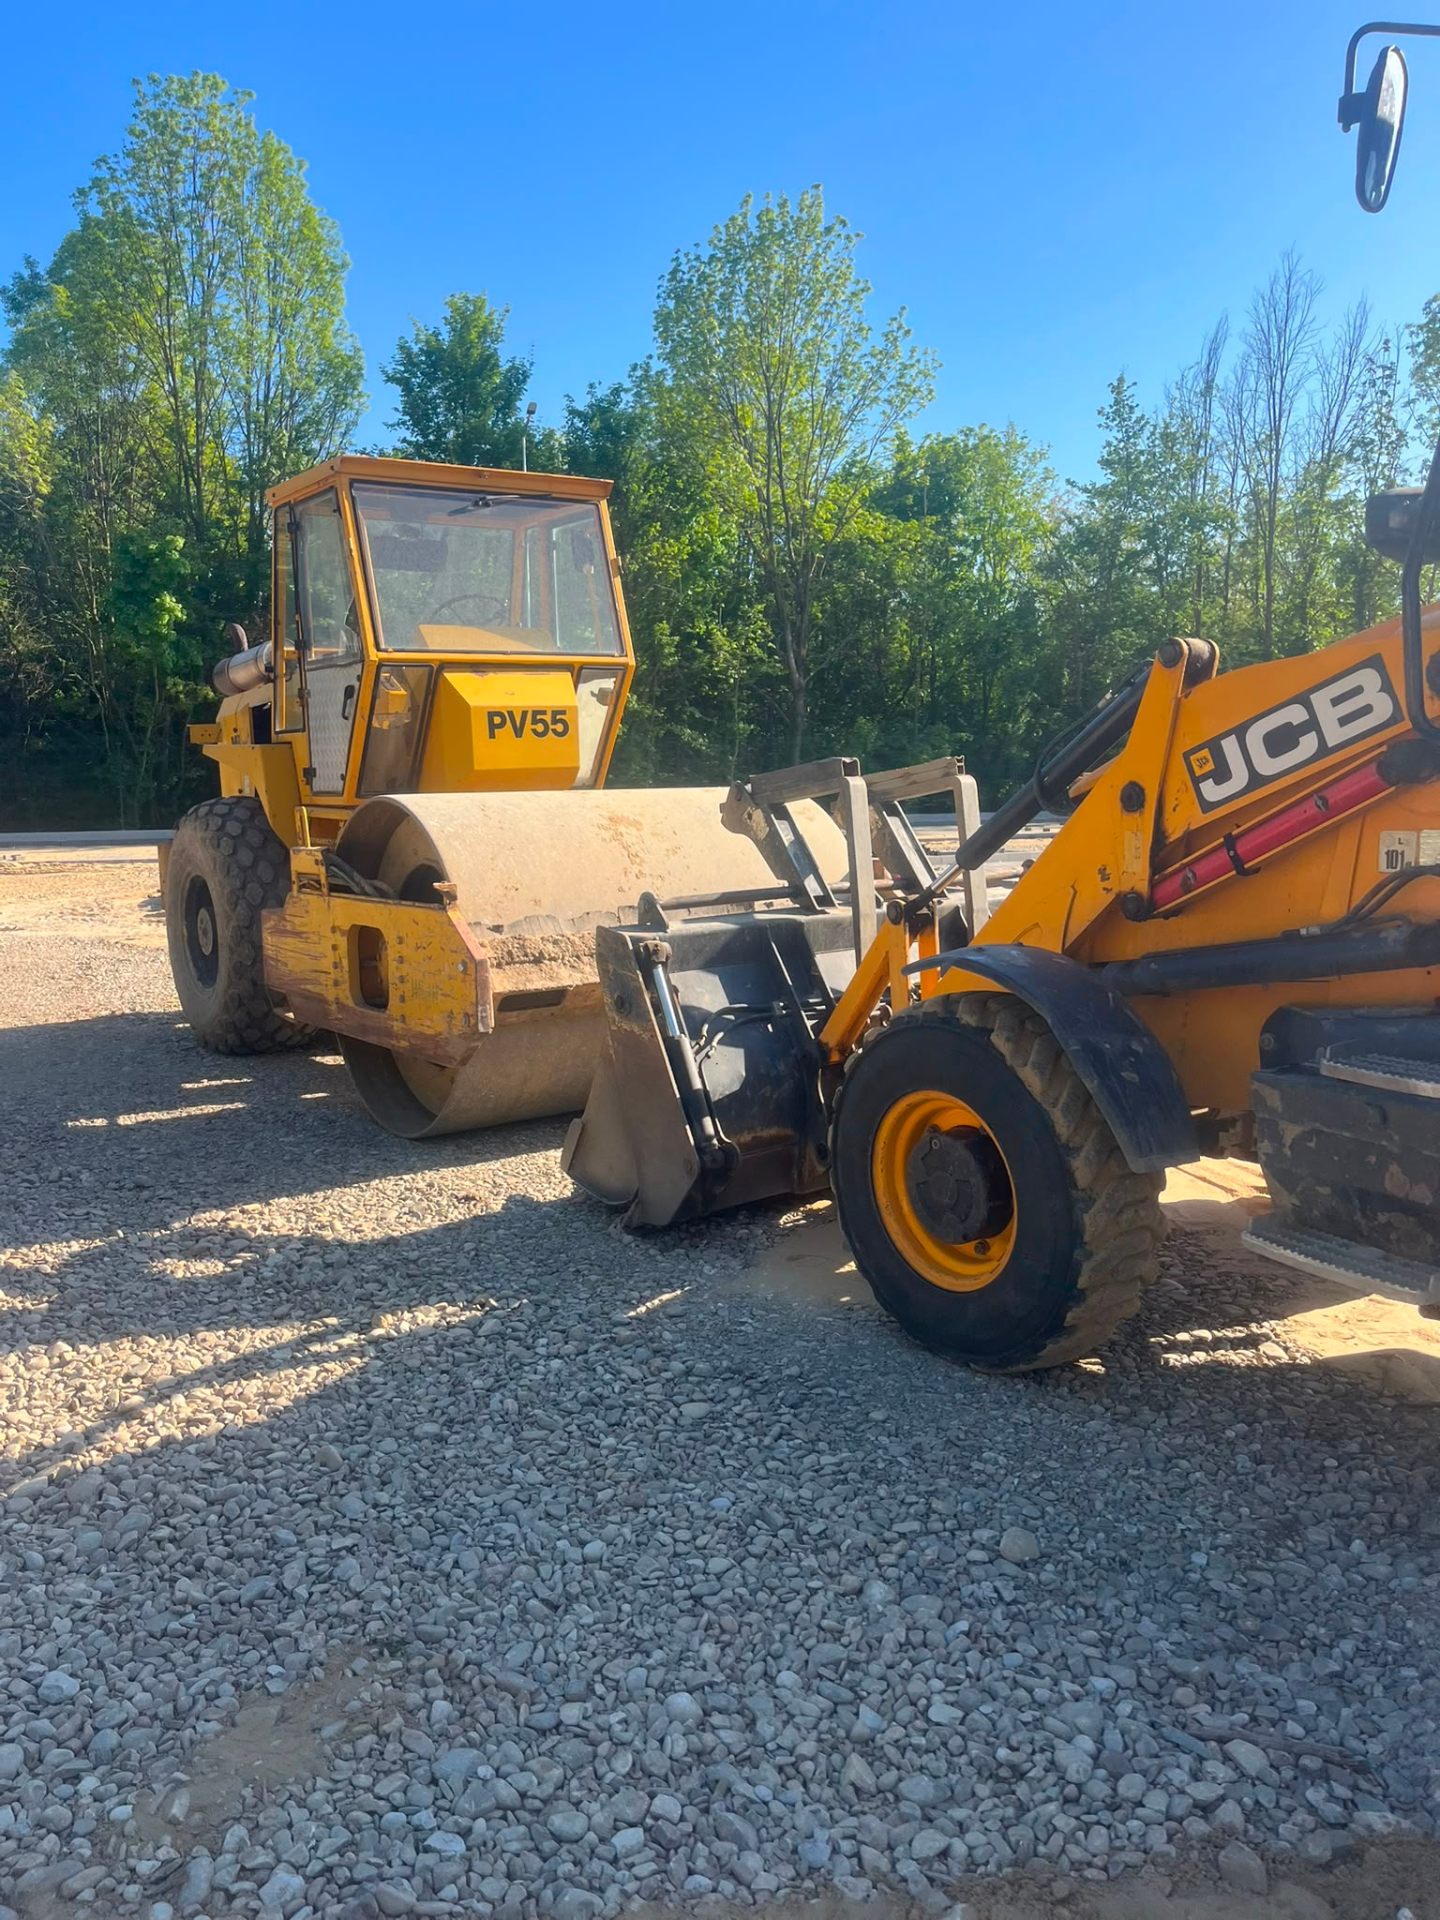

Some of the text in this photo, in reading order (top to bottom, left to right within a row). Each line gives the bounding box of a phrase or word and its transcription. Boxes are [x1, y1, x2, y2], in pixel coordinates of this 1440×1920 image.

[487, 710, 569, 739] PV55
[1199, 668, 1393, 802] JCB
[1384, 849, 1405, 870] 101
